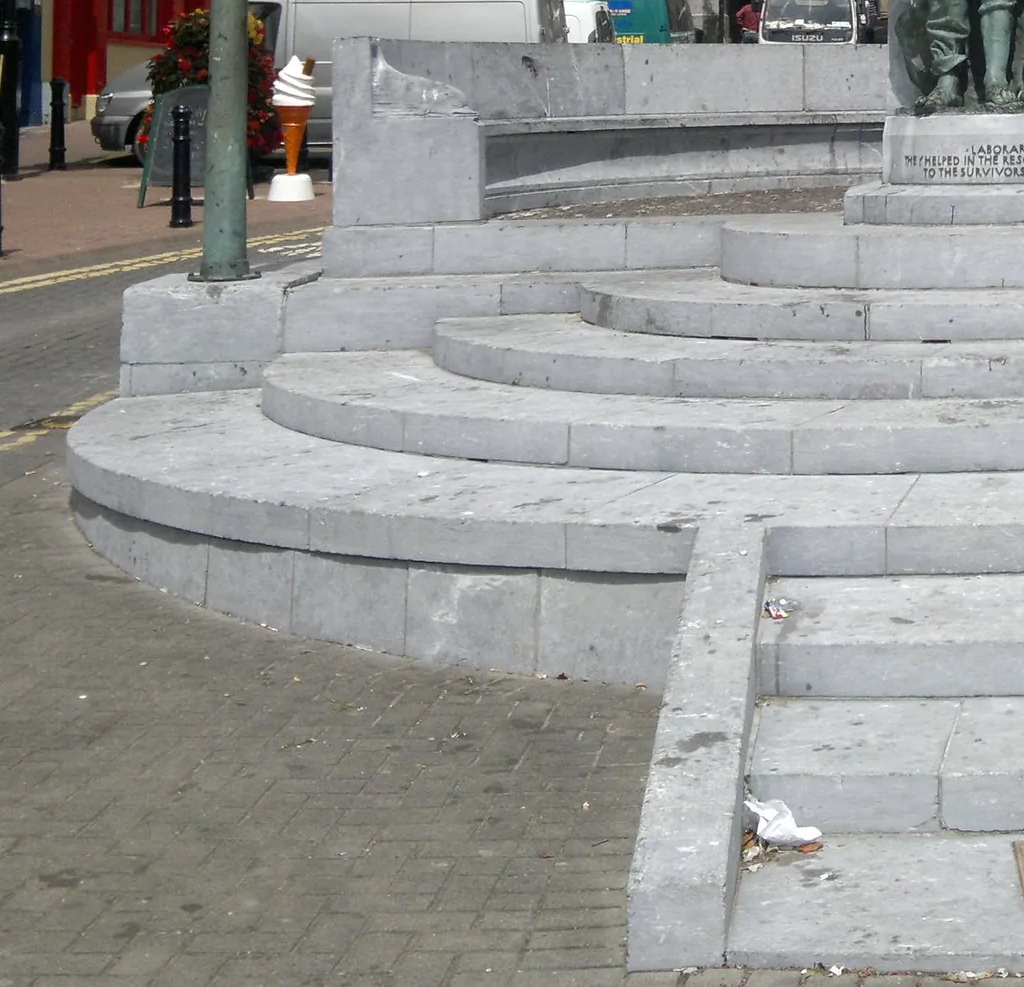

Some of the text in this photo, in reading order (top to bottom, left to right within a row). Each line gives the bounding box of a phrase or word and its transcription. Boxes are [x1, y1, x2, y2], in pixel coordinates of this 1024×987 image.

[616, 35, 644, 44] strial
[791, 34, 823, 42] ISUZU
[904, 155, 923, 167] THEY
[924, 155, 960, 167] HELPED
[964, 155, 975, 166] IN
[978, 155, 999, 166] THE
[923, 167, 936, 178] TO
[939, 167, 958, 178] THE
